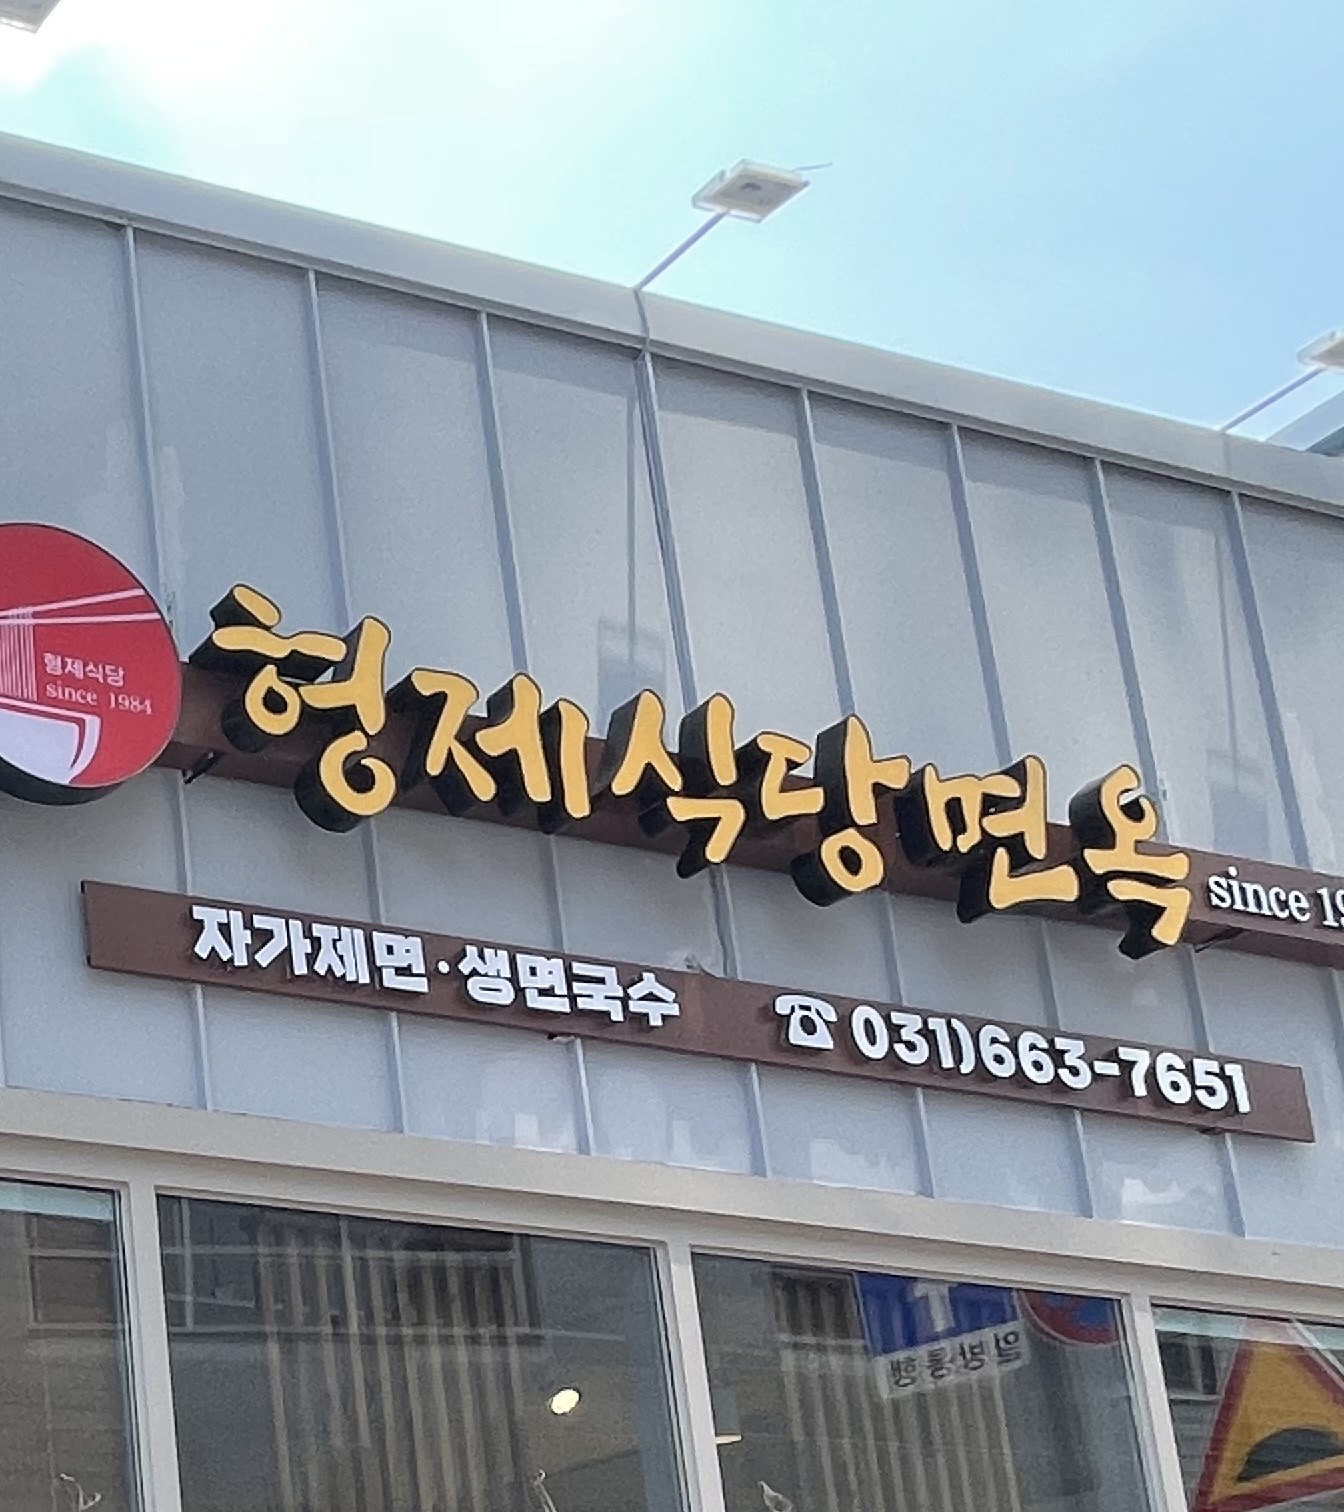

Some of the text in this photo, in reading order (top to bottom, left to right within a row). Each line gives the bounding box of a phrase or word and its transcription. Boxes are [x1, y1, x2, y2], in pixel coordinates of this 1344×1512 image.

[43, 652, 125, 686] 형제식당
[46, 680, 153, 715] since 1984
[1208, 866, 1311, 922] since
